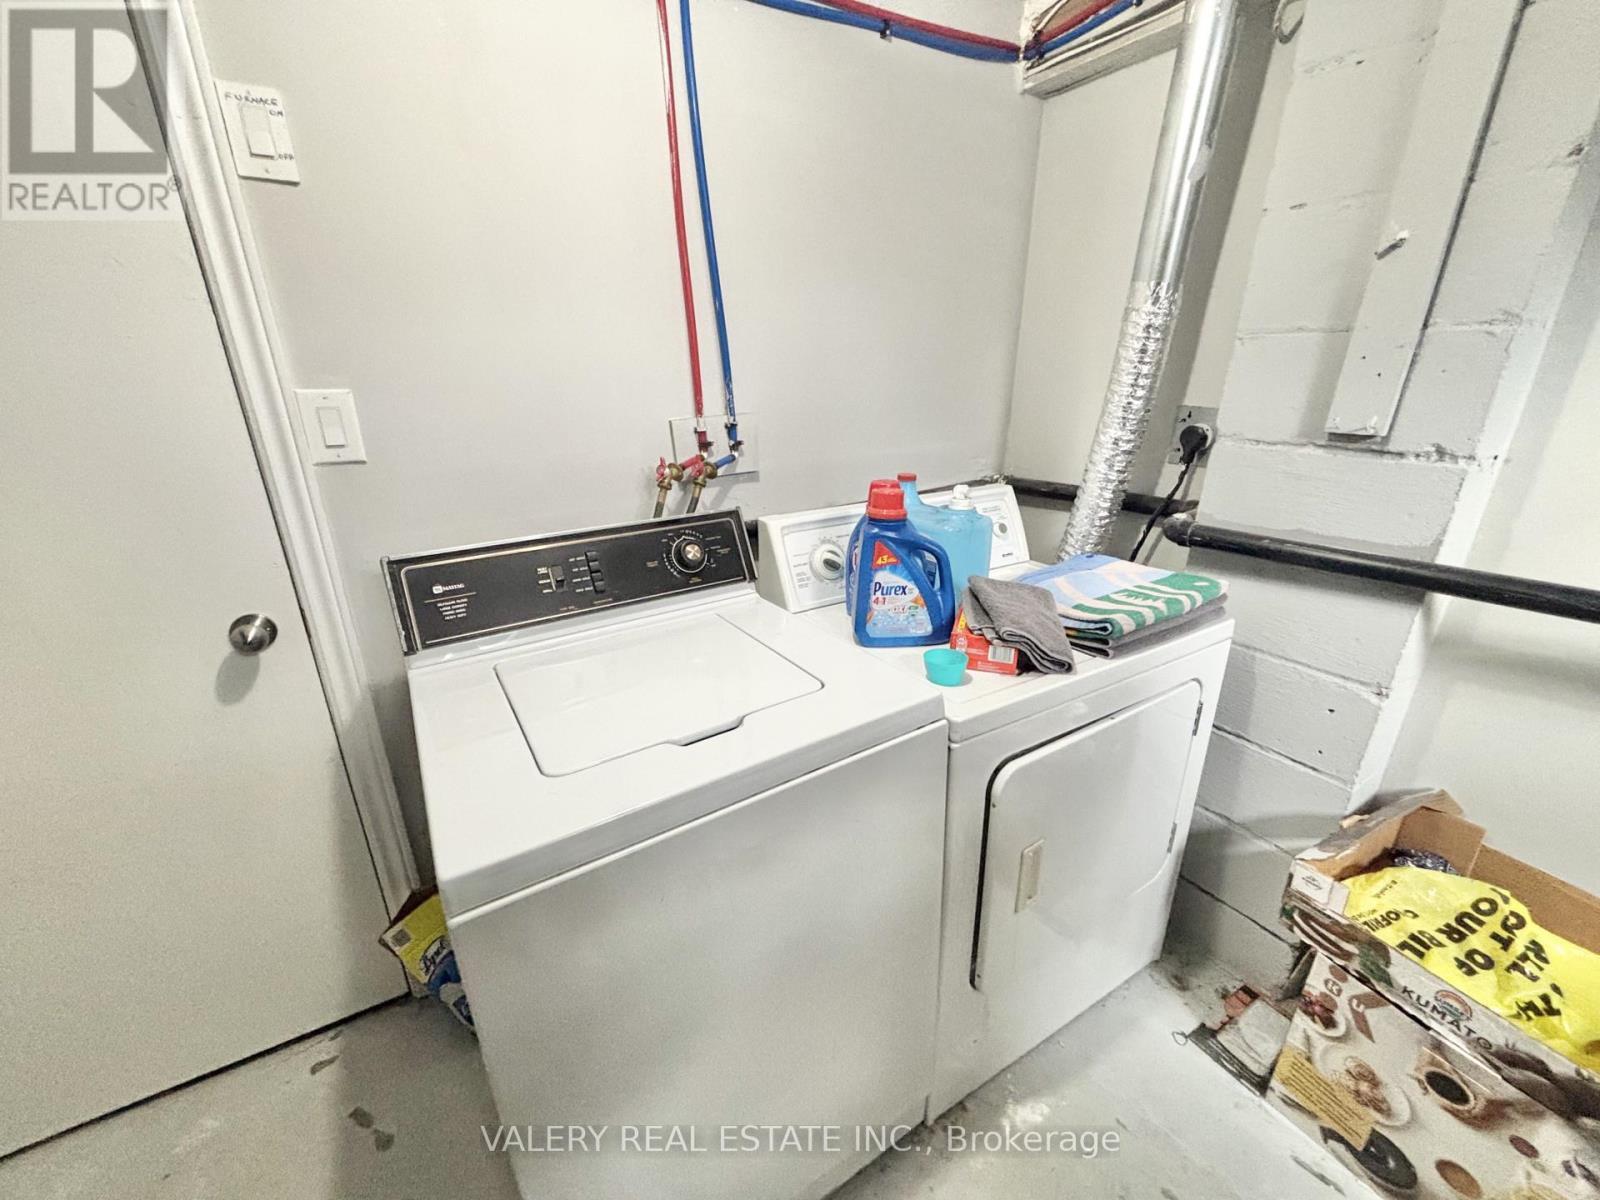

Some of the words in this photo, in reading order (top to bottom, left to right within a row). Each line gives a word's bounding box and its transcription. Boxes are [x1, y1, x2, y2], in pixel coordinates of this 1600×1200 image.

[224, 91, 278, 106] FURNACE
[269, 110, 284, 118] ON
[873, 582, 908, 596] Purex
[1396, 930, 1448, 960] BIL
[1454, 948, 1495, 976] OF
[1402, 986, 1493, 1050] KUMATO
